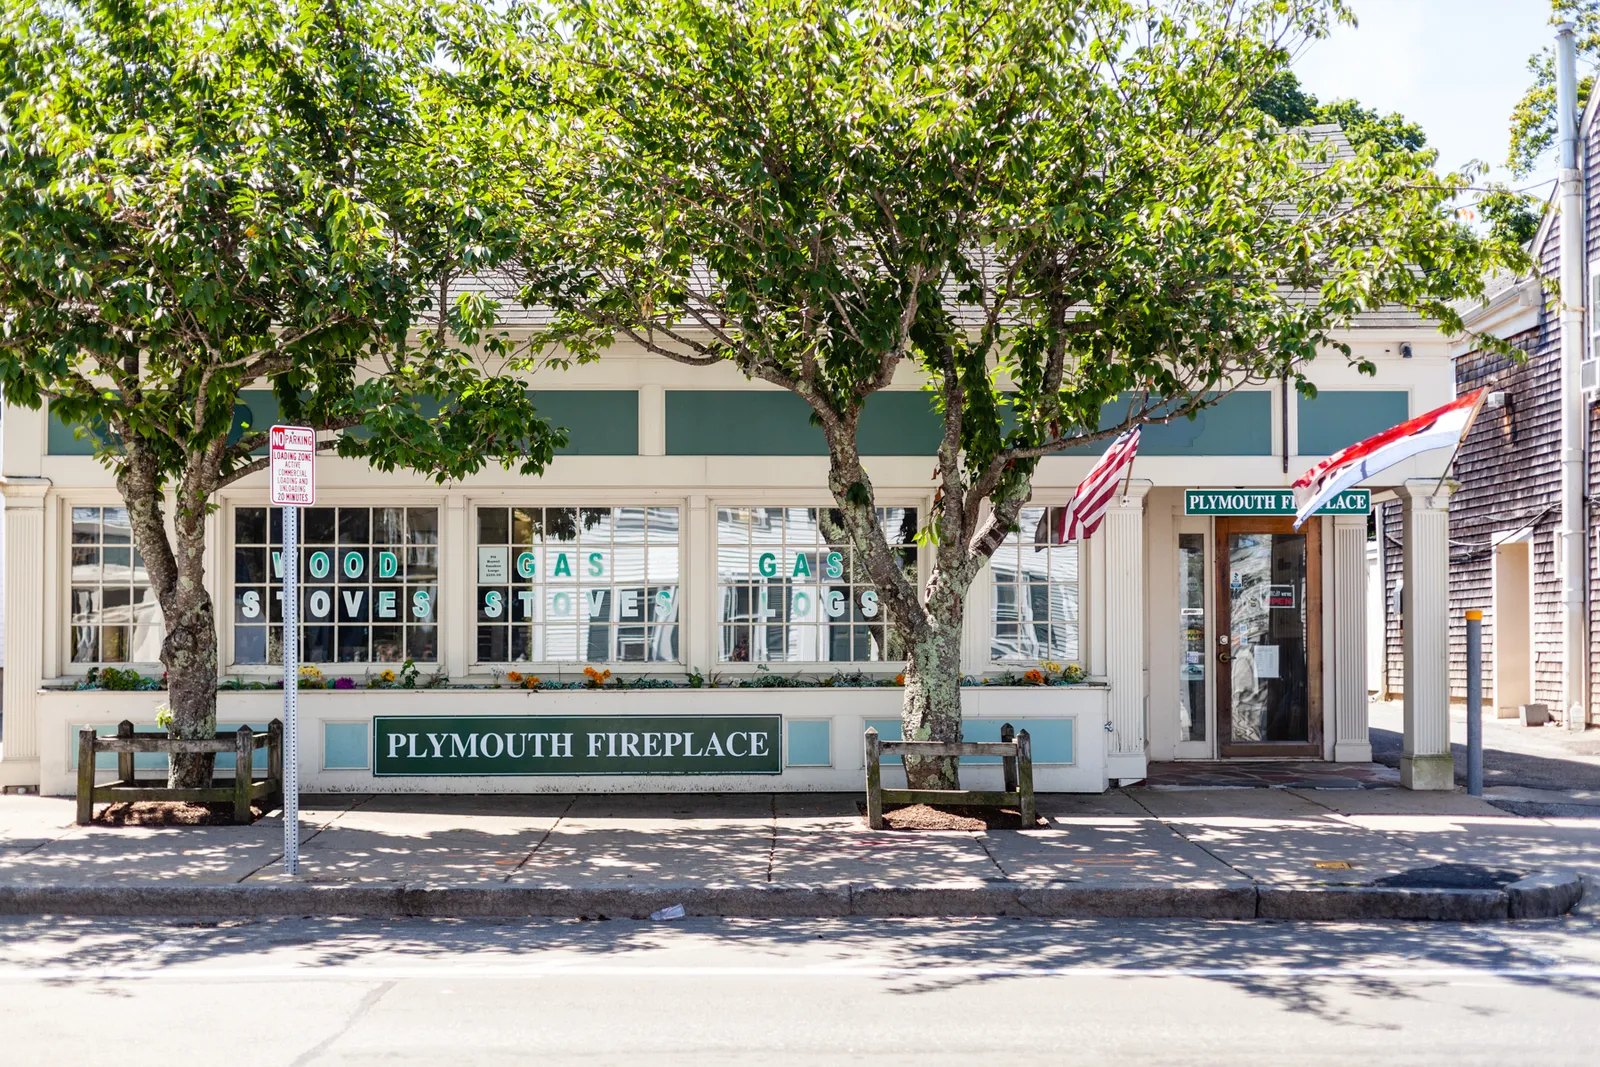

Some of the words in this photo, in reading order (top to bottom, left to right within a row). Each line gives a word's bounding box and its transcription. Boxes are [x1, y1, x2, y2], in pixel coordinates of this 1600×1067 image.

[273, 431, 284, 446] NO
[285, 435, 312, 446] PARKING
[274, 451, 296, 460] LOADING
[298, 453, 311, 461] ZONE
[278, 469, 307, 477] COMMERCIAL
[278, 493, 285, 501] 20
[286, 493, 309, 502] MINUTES
[1189, 494, 1276, 510] PLYMOUTH
[1281, 494, 1367, 509] FILACE
[516, 551, 605, 578] GAS
[758, 552, 844, 578] GAS
[484, 590, 672, 618] STOVES
[760, 590, 879, 618] LOGS
[386, 732, 574, 759] PLYMOUTH
[586, 731, 769, 758] FIREPLACE
